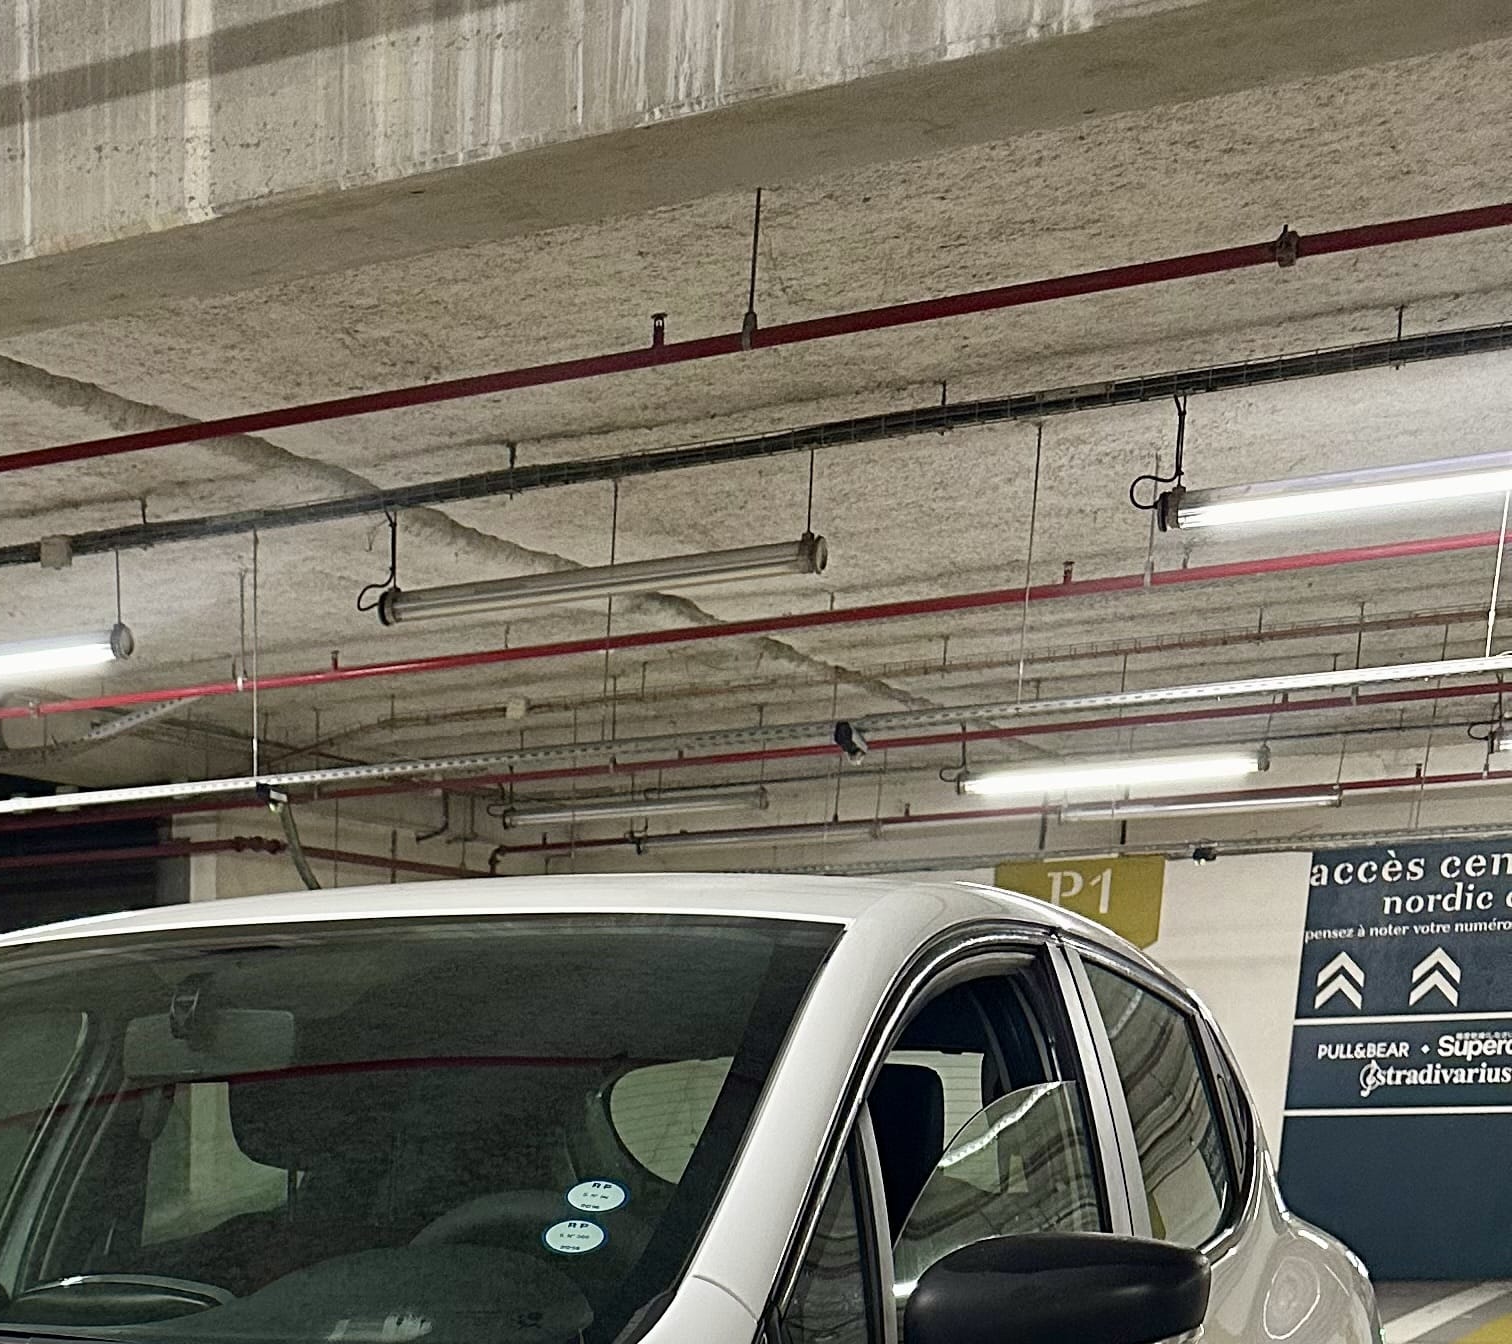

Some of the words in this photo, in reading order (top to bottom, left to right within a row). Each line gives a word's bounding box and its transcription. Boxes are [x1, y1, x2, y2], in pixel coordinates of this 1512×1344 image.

[1310, 850, 1425, 887] accès
[1048, 868, 1112, 914] P1
[1383, 882, 1494, 915] nordic
[1304, 926, 1355, 943] pensez
[1357, 924, 1366, 938] à
[1369, 925, 1410, 938] noter
[1413, 923, 1451, 935] votre
[1317, 1042, 1410, 1060] PULL&BEAR
